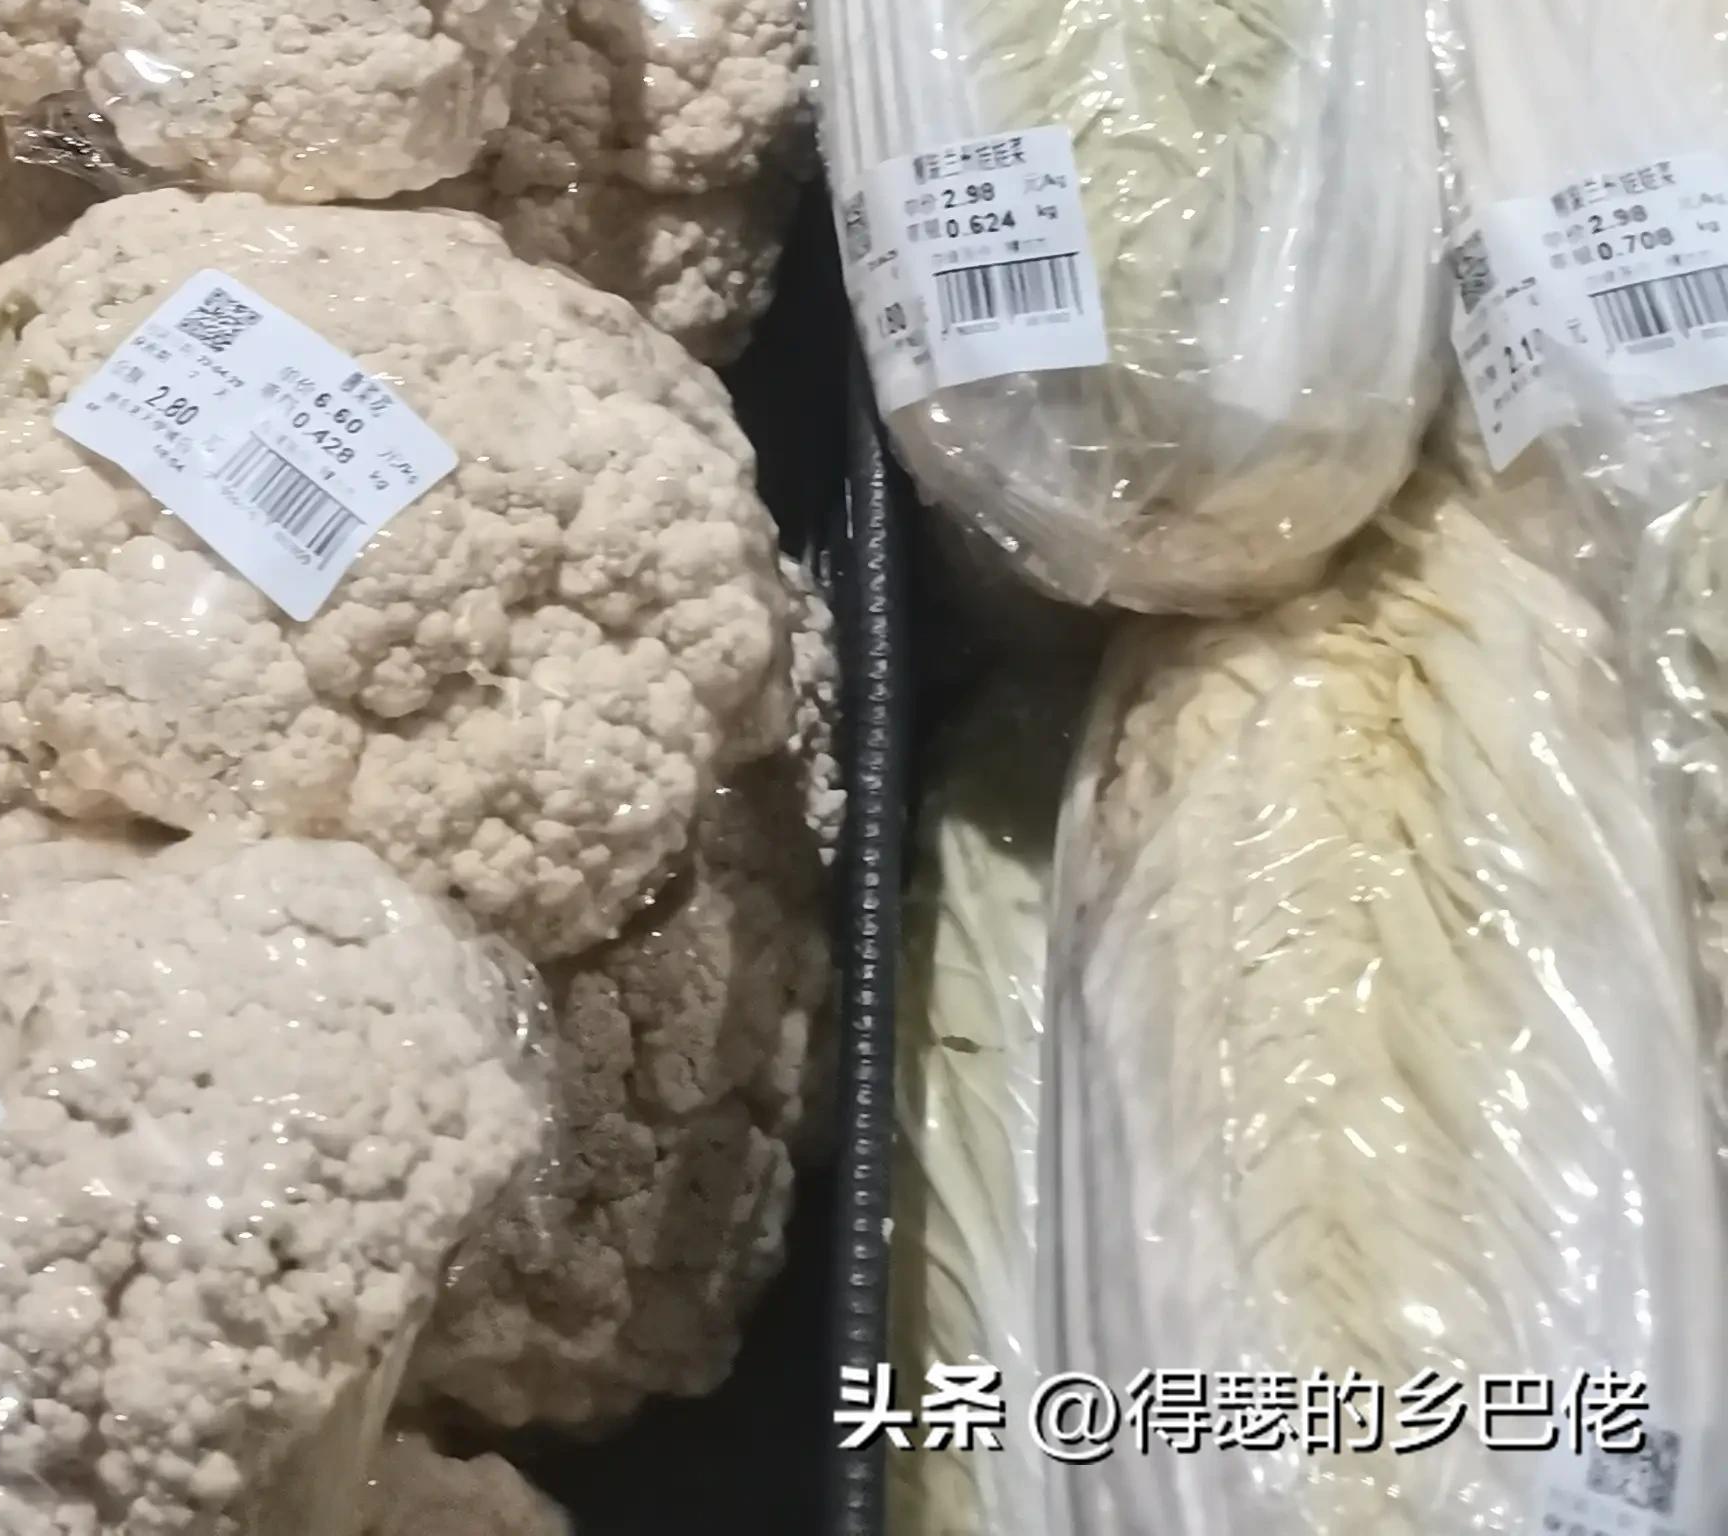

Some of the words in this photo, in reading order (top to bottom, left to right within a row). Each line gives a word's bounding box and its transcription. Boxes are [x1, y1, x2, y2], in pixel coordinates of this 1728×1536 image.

[941, 182, 996, 209] 2.98
[144, 384, 200, 425] 2.80
[292, 411, 355, 465] 0.428
